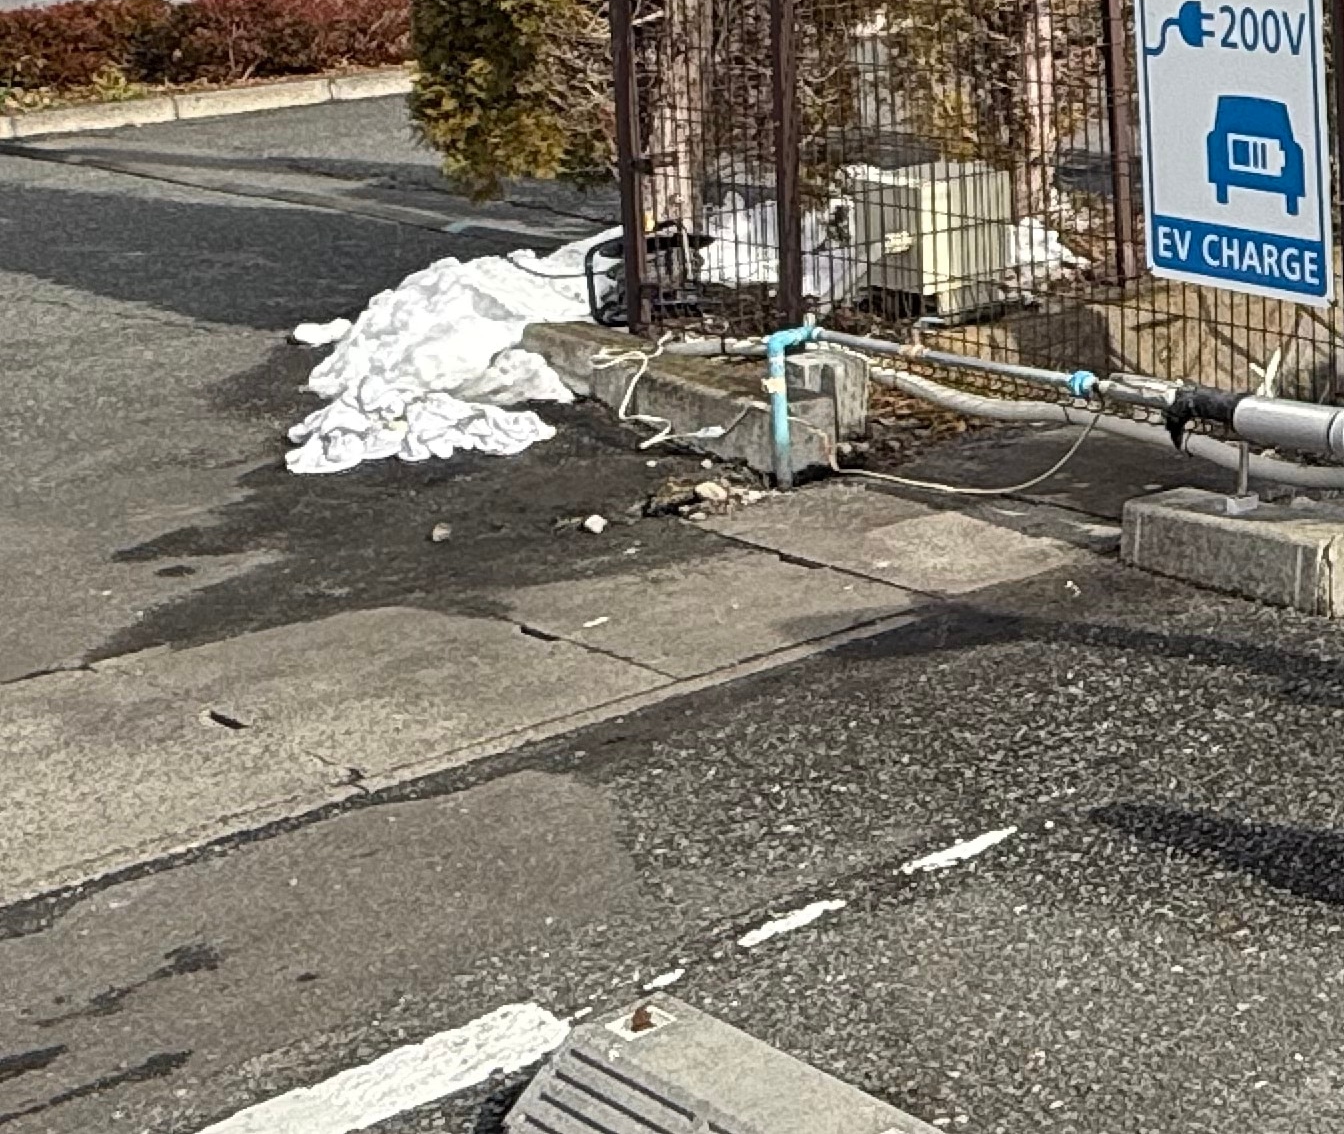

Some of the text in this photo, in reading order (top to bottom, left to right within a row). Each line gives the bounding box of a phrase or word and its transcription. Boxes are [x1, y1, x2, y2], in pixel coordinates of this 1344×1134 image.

[1219, 4, 1306, 56] 200V
[1158, 226, 1320, 285] EV CHARGE
